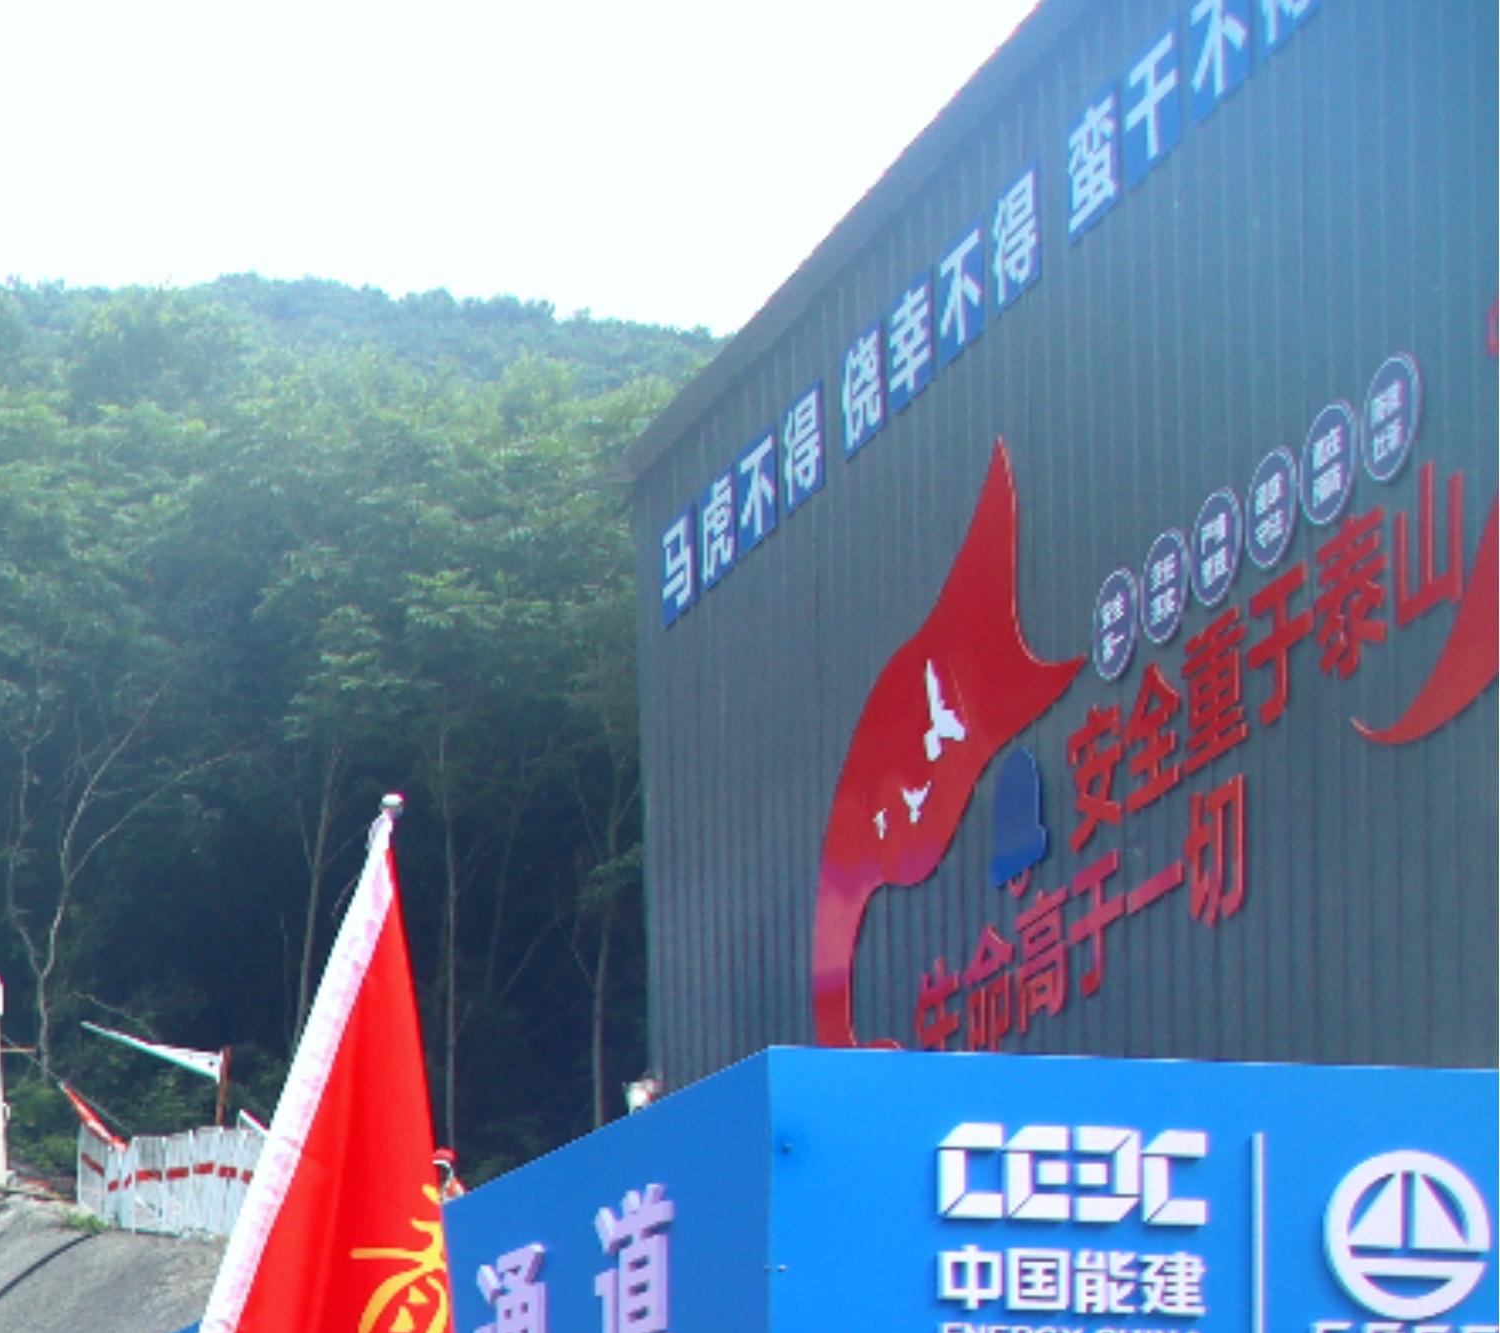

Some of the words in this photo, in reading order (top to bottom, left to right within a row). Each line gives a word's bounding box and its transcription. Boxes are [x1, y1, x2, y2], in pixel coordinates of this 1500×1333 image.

[1066, 460, 1463, 851] 安全重于泰山
[937, 1245, 1207, 1317] 中国能建
